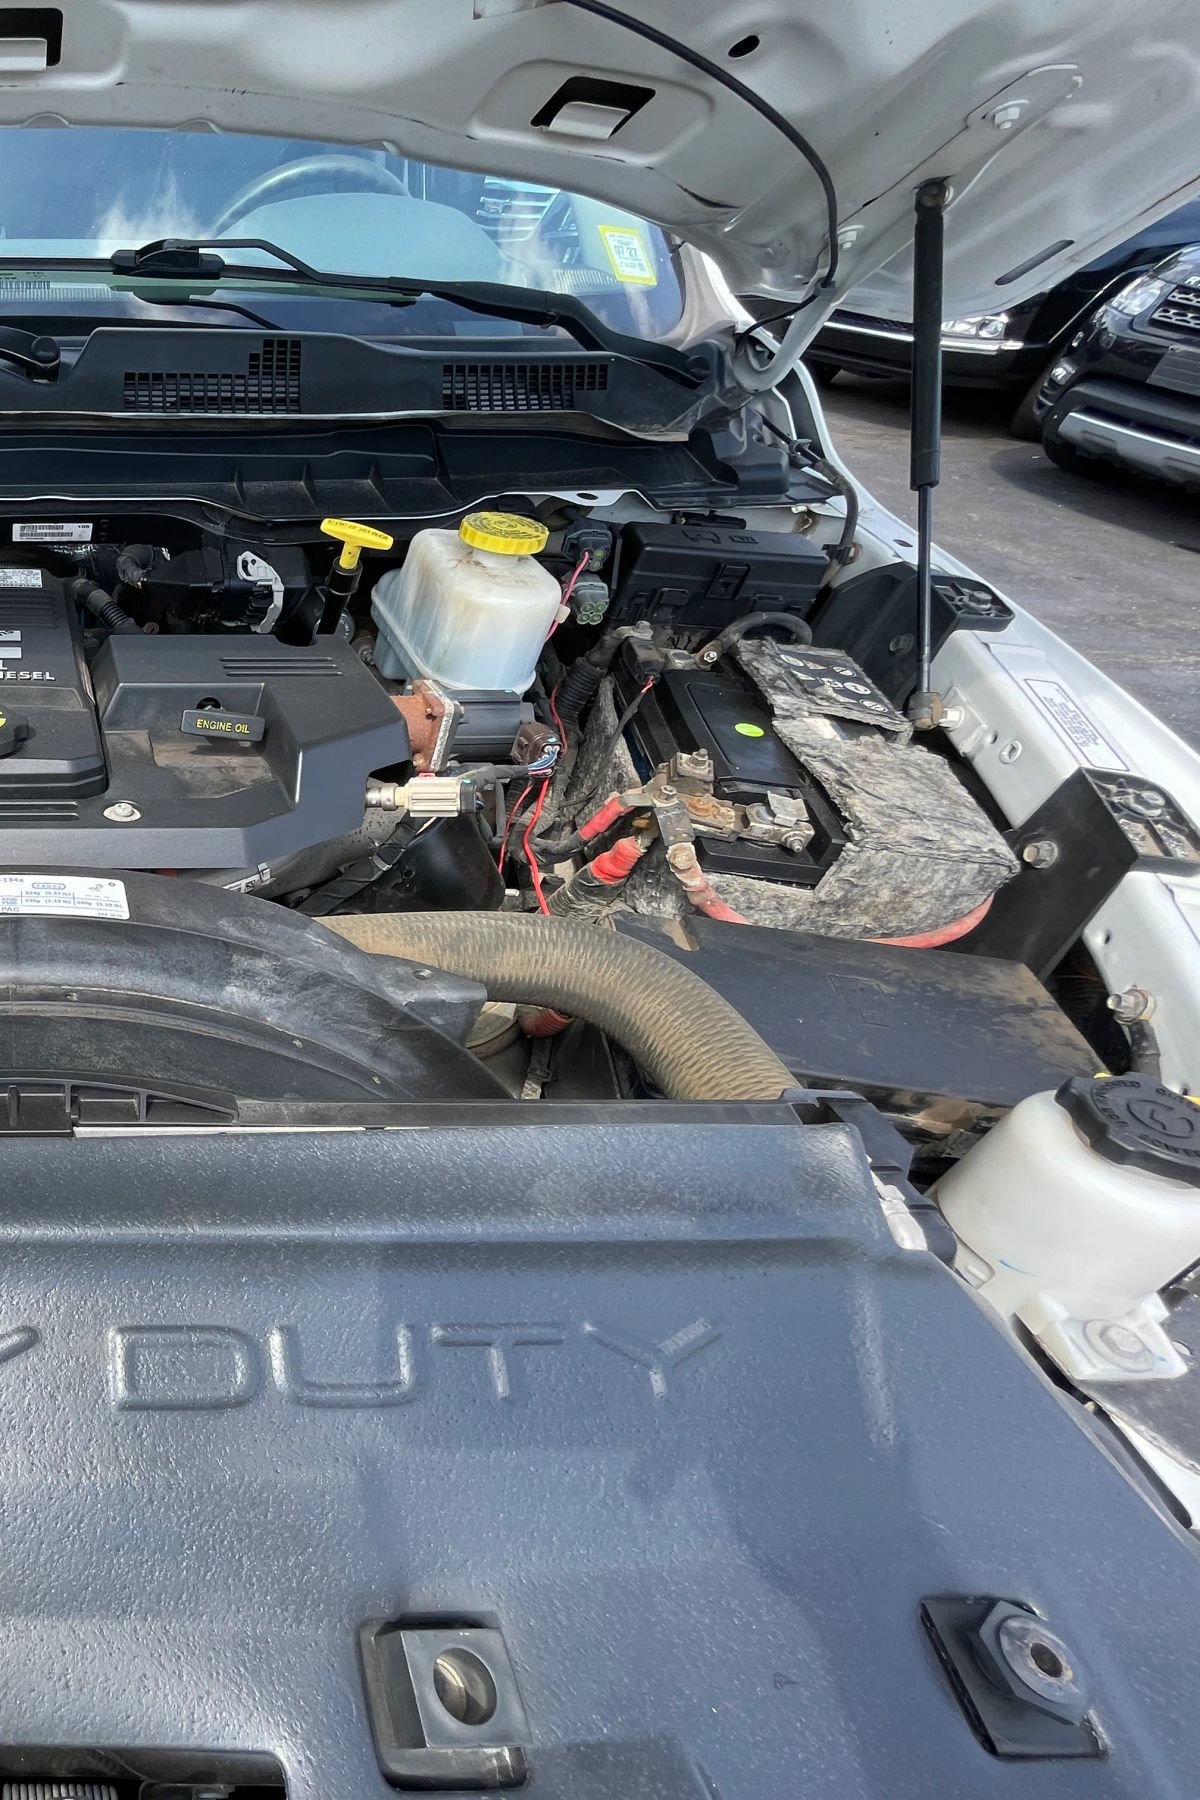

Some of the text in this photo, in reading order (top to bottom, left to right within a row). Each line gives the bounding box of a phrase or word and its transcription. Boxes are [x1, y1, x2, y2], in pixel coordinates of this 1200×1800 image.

[196, 718, 251, 734] ENGINE OIL
[108, 1316, 723, 1411] DUTY
